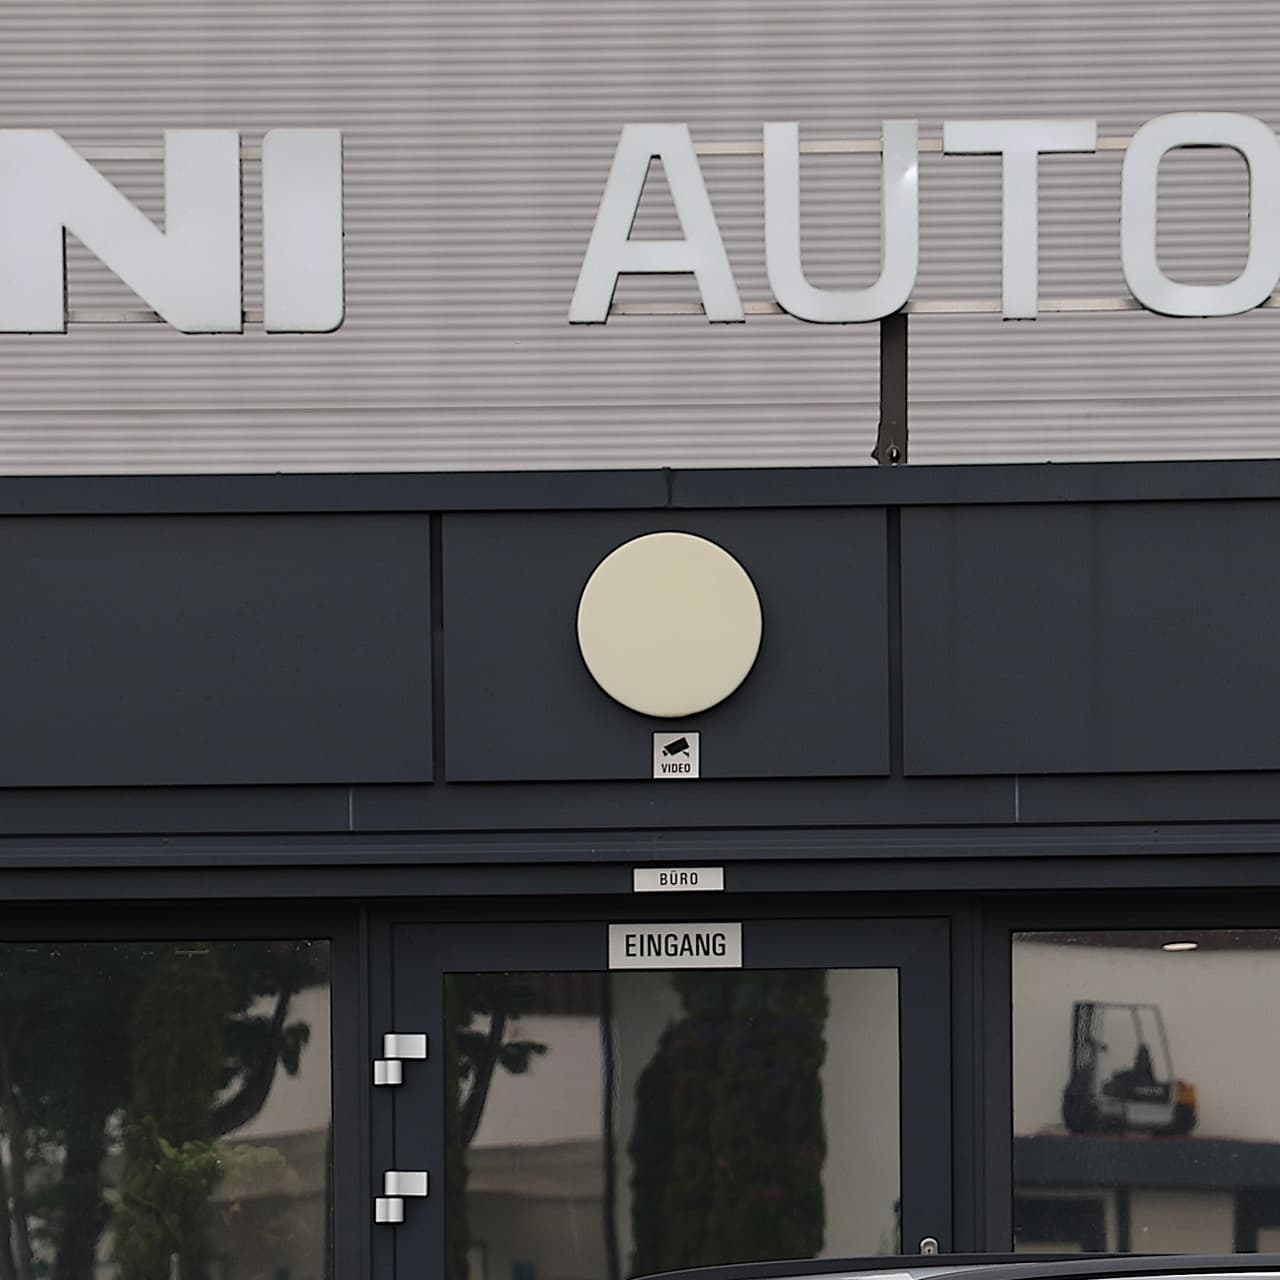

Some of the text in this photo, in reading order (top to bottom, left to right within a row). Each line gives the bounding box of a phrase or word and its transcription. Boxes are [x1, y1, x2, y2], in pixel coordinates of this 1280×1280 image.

[661, 762, 691, 774] VIDEO
[659, 870, 699, 886] BÜRO
[624, 932, 727, 958] EINGANG
